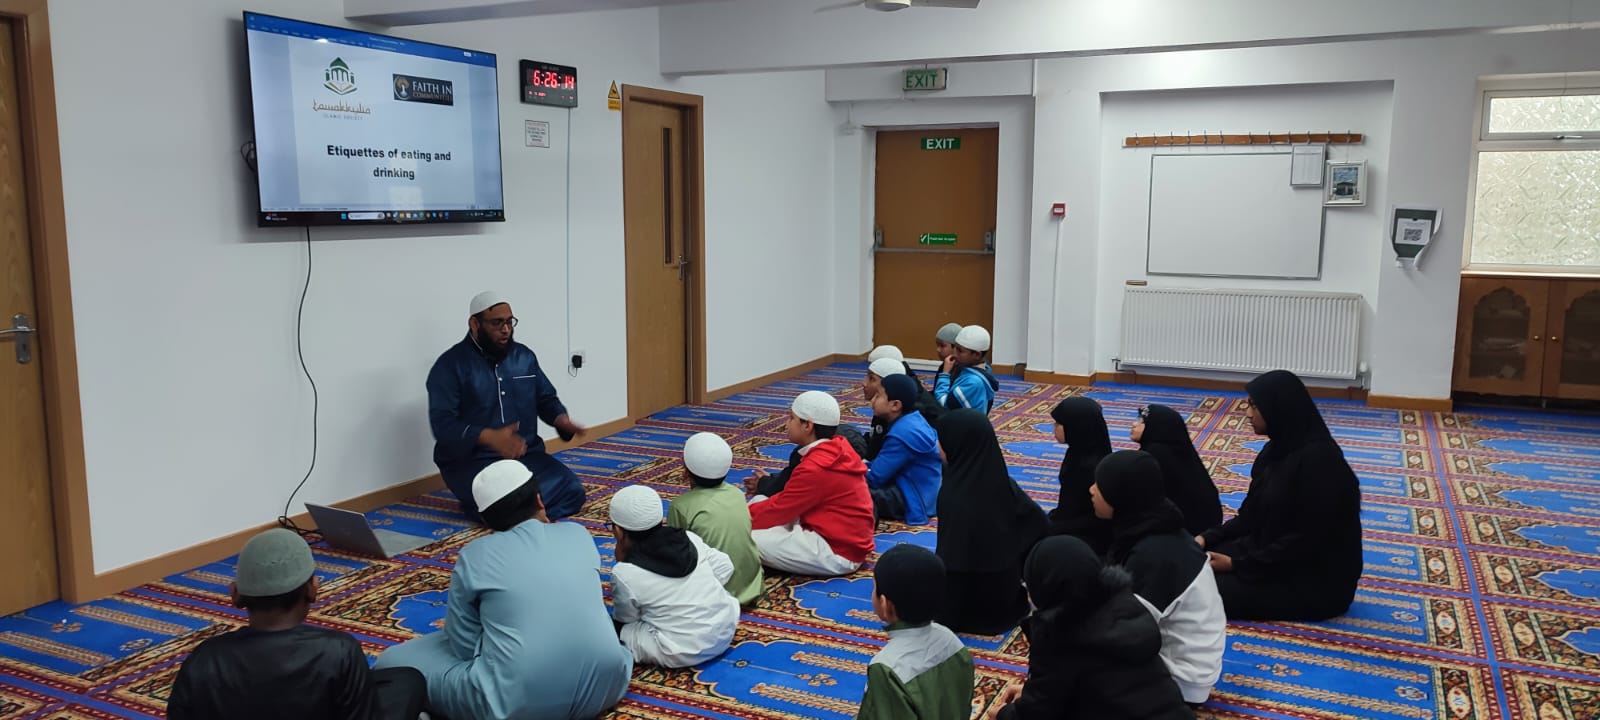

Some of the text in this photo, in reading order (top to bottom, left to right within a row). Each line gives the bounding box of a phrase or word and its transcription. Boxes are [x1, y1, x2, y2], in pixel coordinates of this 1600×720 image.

[906, 73, 938, 88] EXIT
[412, 81, 452, 95] FAITH IN
[926, 138, 955, 149] EXIT
[327, 145, 451, 162] Etiquettes of eating and
[373, 167, 415, 180] drinking
